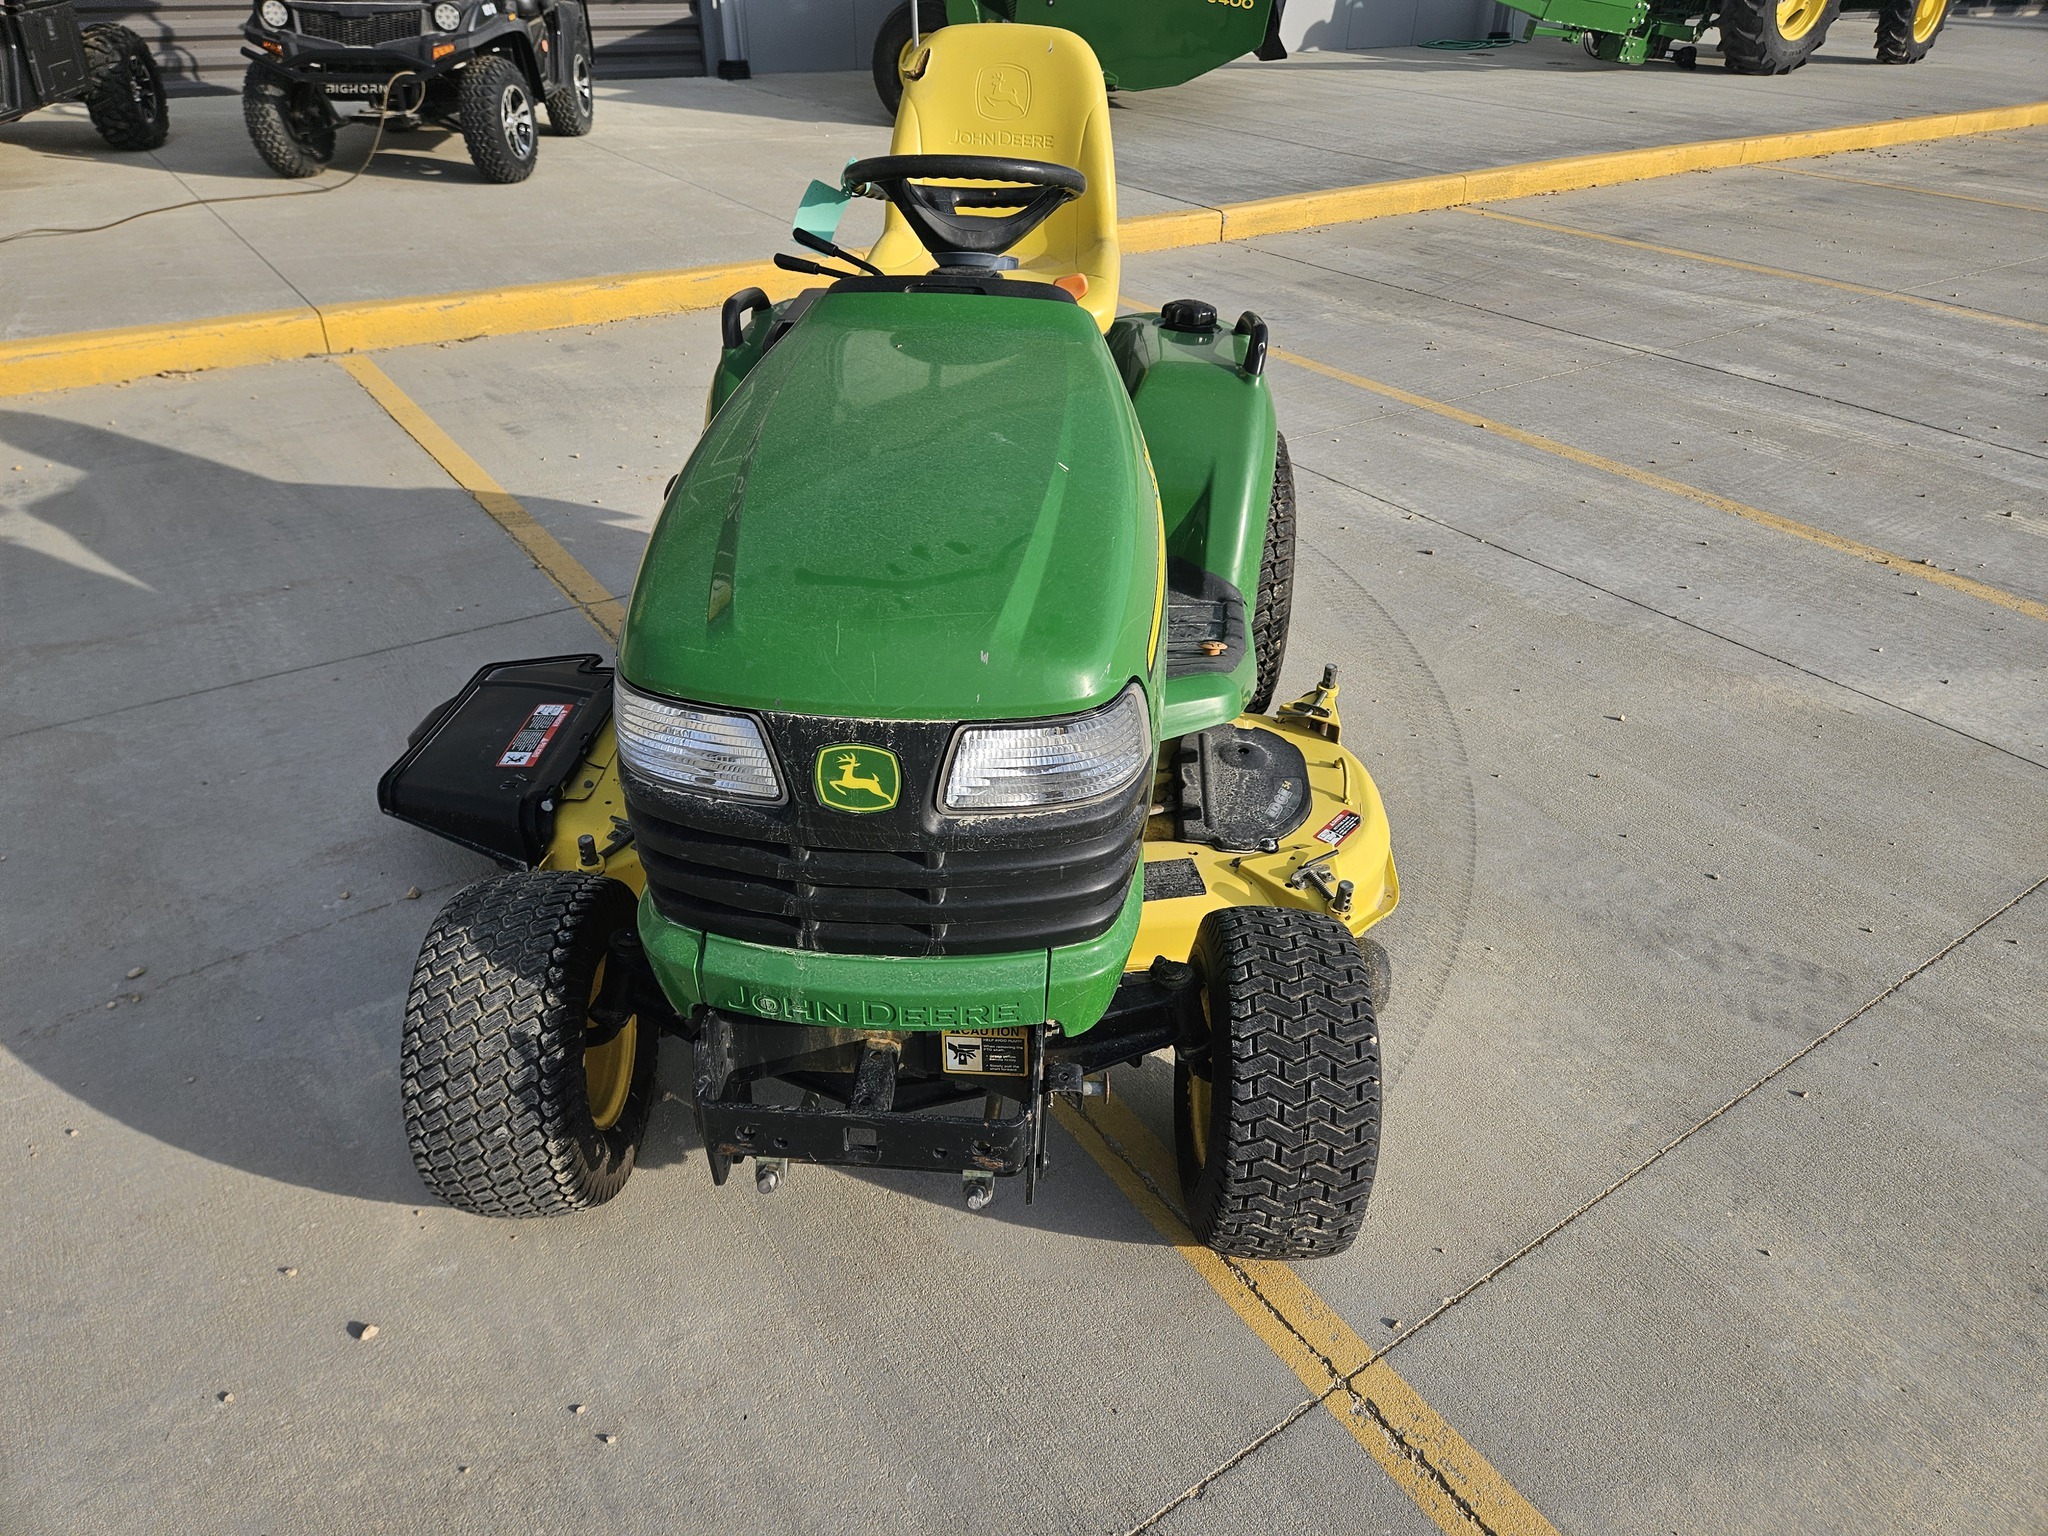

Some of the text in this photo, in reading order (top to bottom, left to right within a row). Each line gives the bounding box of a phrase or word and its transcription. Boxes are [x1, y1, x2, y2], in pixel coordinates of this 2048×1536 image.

[1207, 0, 1254, 10] 400
[325, 83, 389, 94] BIGHORN
[949, 129, 1054, 149] JOHN DEERE
[1265, 787, 1292, 820] EDGE
[728, 986, 1020, 1026] JOHN DEERE
[961, 1027, 1020, 1037] CAUTION
